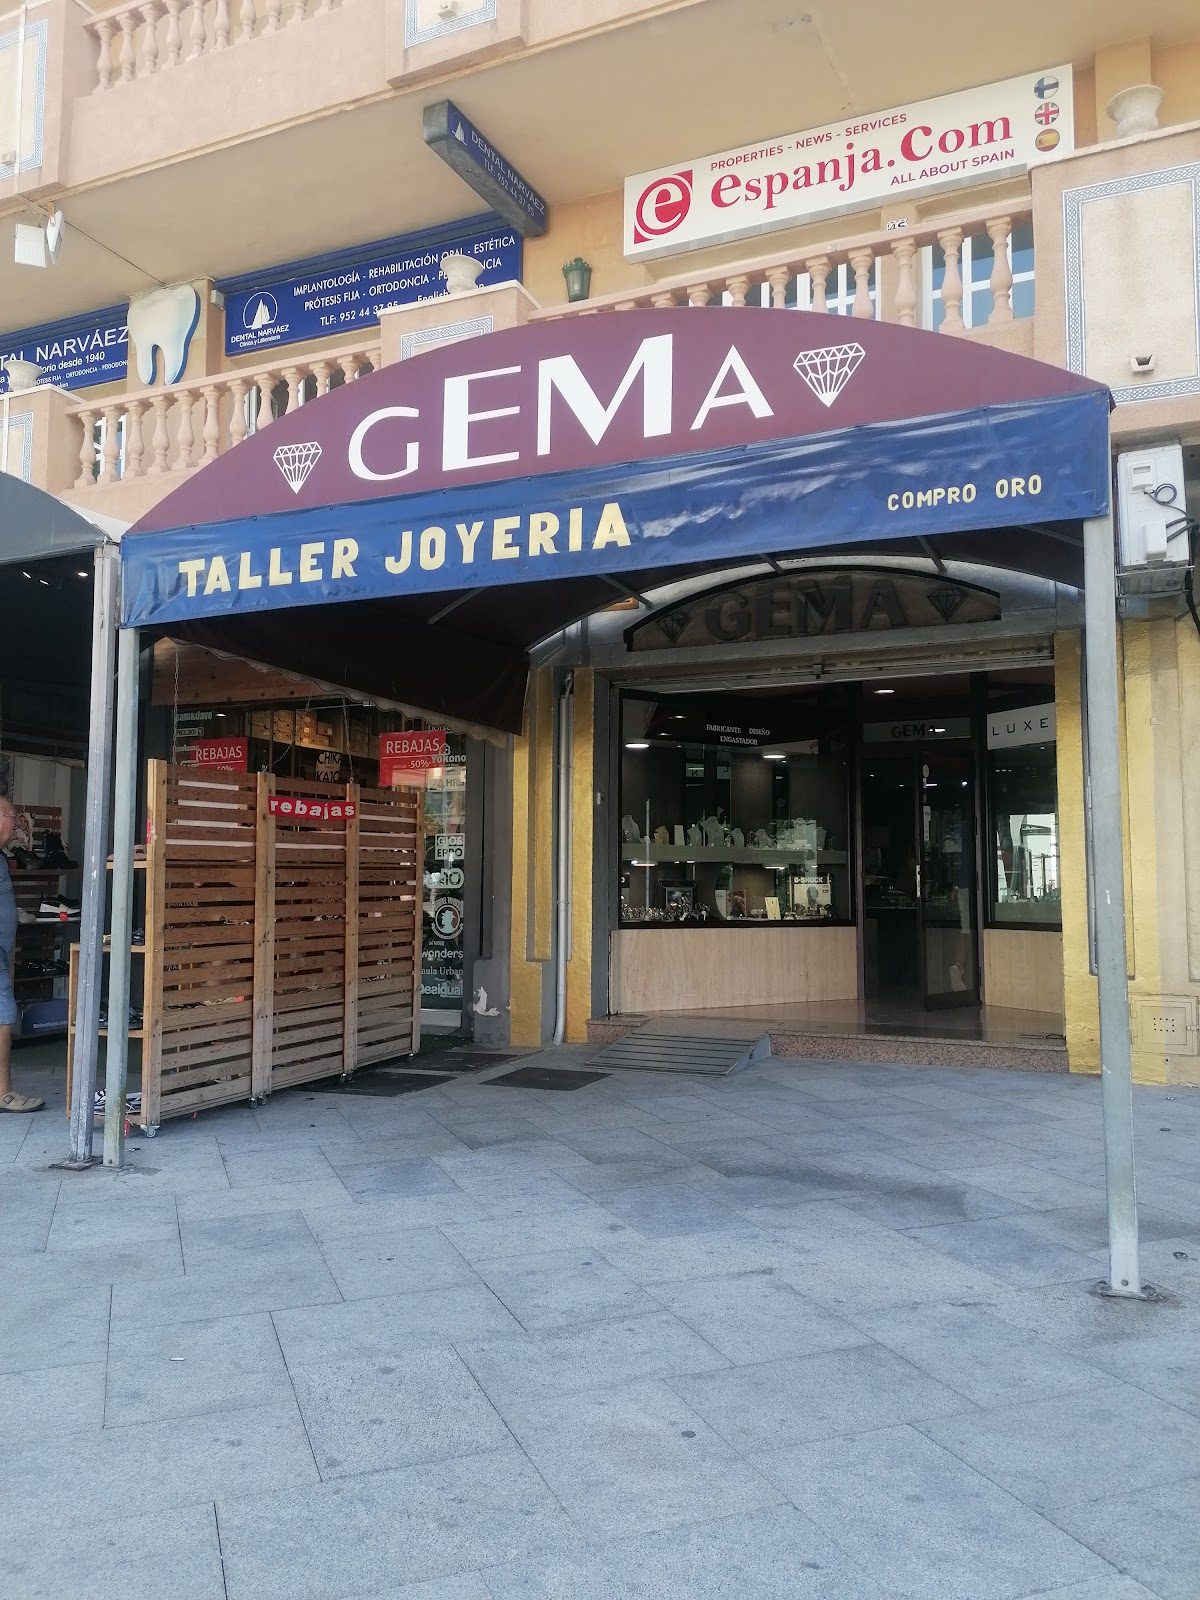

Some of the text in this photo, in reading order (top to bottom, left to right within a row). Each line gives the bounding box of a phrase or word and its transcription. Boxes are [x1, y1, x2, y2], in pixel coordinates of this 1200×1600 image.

[471, 130, 506, 174] DENTAL
[710, 145, 784, 171] PROPERTIES
[796, 132, 833, 149] NEWS
[845, 113, 907, 137] SERVICES
[710, 116, 1013, 211] espanja.Com
[890, 149, 1015, 186] ALL ABOUT SPAIN
[293, 270, 361, 297] IMPLANTOLOGÍA
[369, 252, 439, 279] REHABILITACIÓN
[474, 235, 516, 254] ESTÉTICA
[304, 293, 342, 311] PRÓTESIS
[343, 290, 360, 302] FIJA
[369, 274, 430, 297] ORTODONCIA
[230, 323, 290, 344] DENTAL NARVÁEZ
[320, 314, 337, 327] TLF:
[339, 310, 356, 322] 952
[359, 307, 370, 317] 44
[36, 325, 129, 362] NARVÁEZ
[58, 357, 83, 371] desde
[85, 351, 106, 364] 1940
[347, 333, 775, 481] GEMA
[887, 474, 1042, 512] COMPRO ORO
[178, 502, 633, 598] TALLER JOYERIA
[702, 574, 908, 642] GEMA
[706, 723, 771, 737] FABRICANTE DISEÑO
[719, 735, 758, 746] ENGASTADOR
[891, 724, 937, 738] GEMA
[992, 717, 1049, 736] LUXE
[195, 745, 243, 761] REBAJAS
[386, 738, 441, 755] REBAJAS
[270, 800, 355, 820] rebajas
